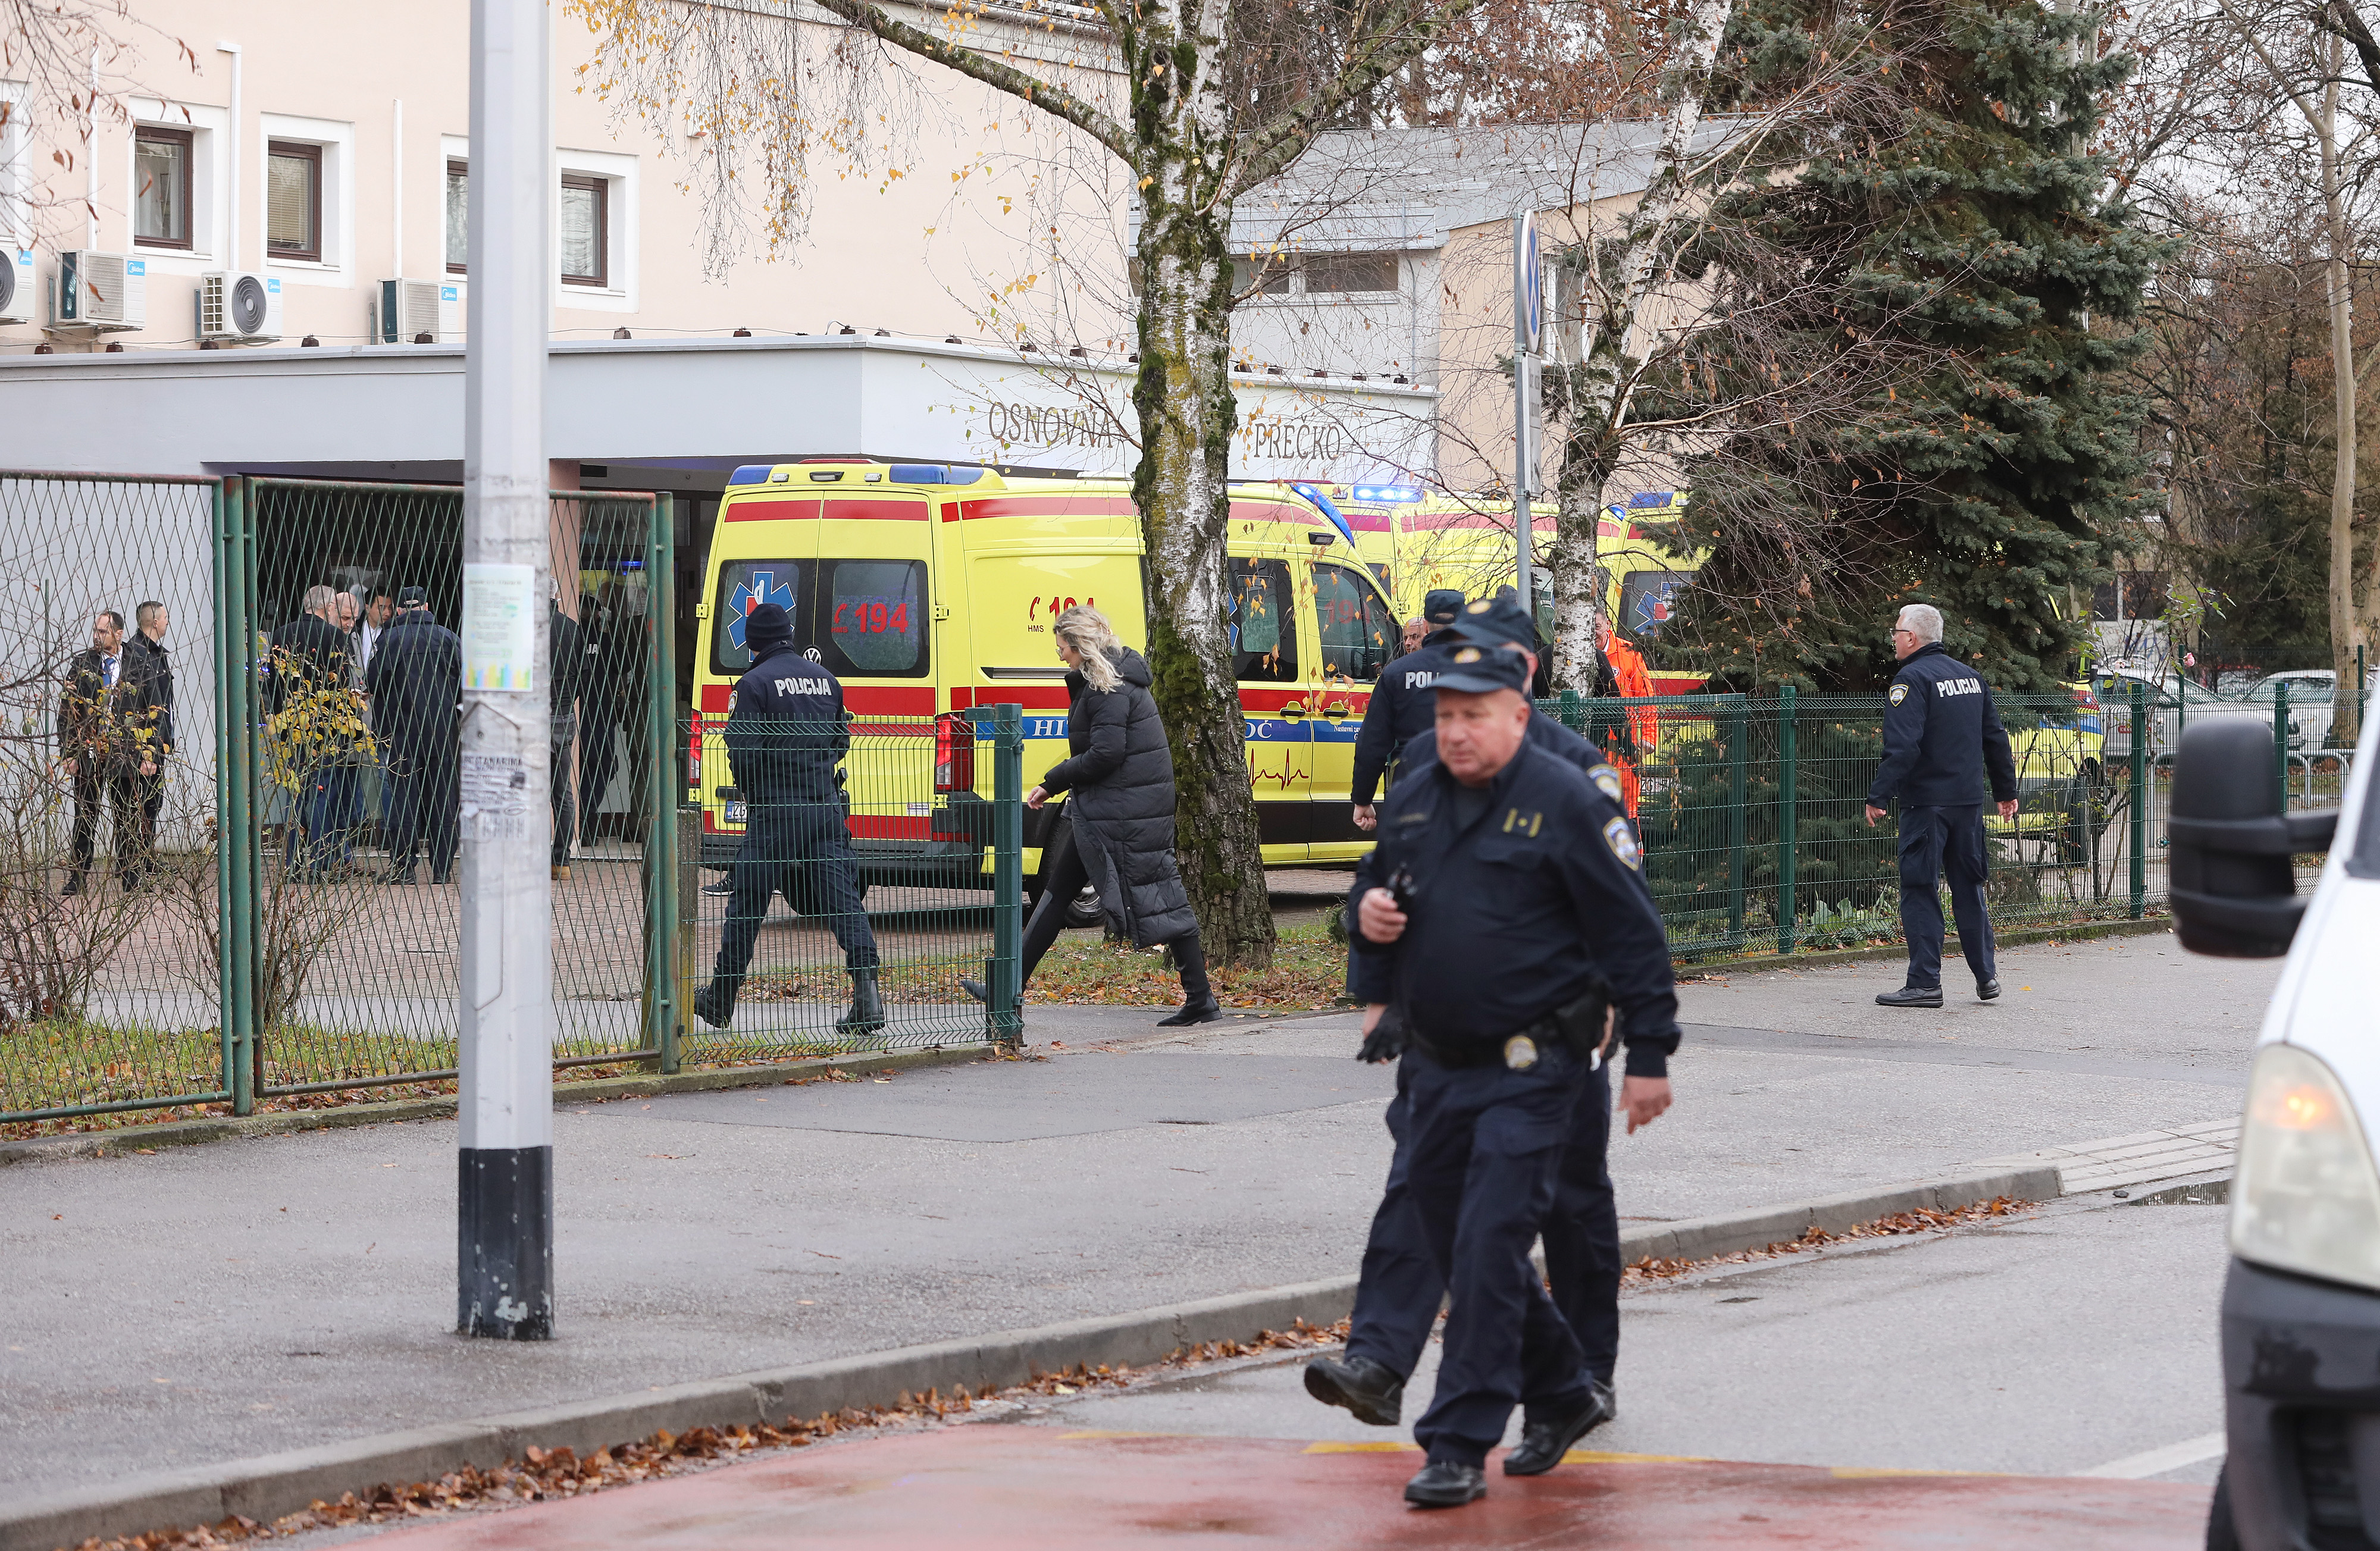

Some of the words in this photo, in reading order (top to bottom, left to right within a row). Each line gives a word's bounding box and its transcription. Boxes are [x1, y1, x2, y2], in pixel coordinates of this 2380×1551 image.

[130, 264, 143, 273] Midea
[443, 290, 456, 298] Midea
[989, 402, 1113, 448] OSNOVNA
[1254, 415, 1340, 460] PREČKO
[855, 603, 909, 633] 194
[774, 678, 832, 697] POLICIJA
[1936, 678, 1982, 697] POLICIJA
[1032, 719, 1068, 736] HI
[1245, 720, 1272, 738] OĆ
[732, 802, 746, 817] ZG
